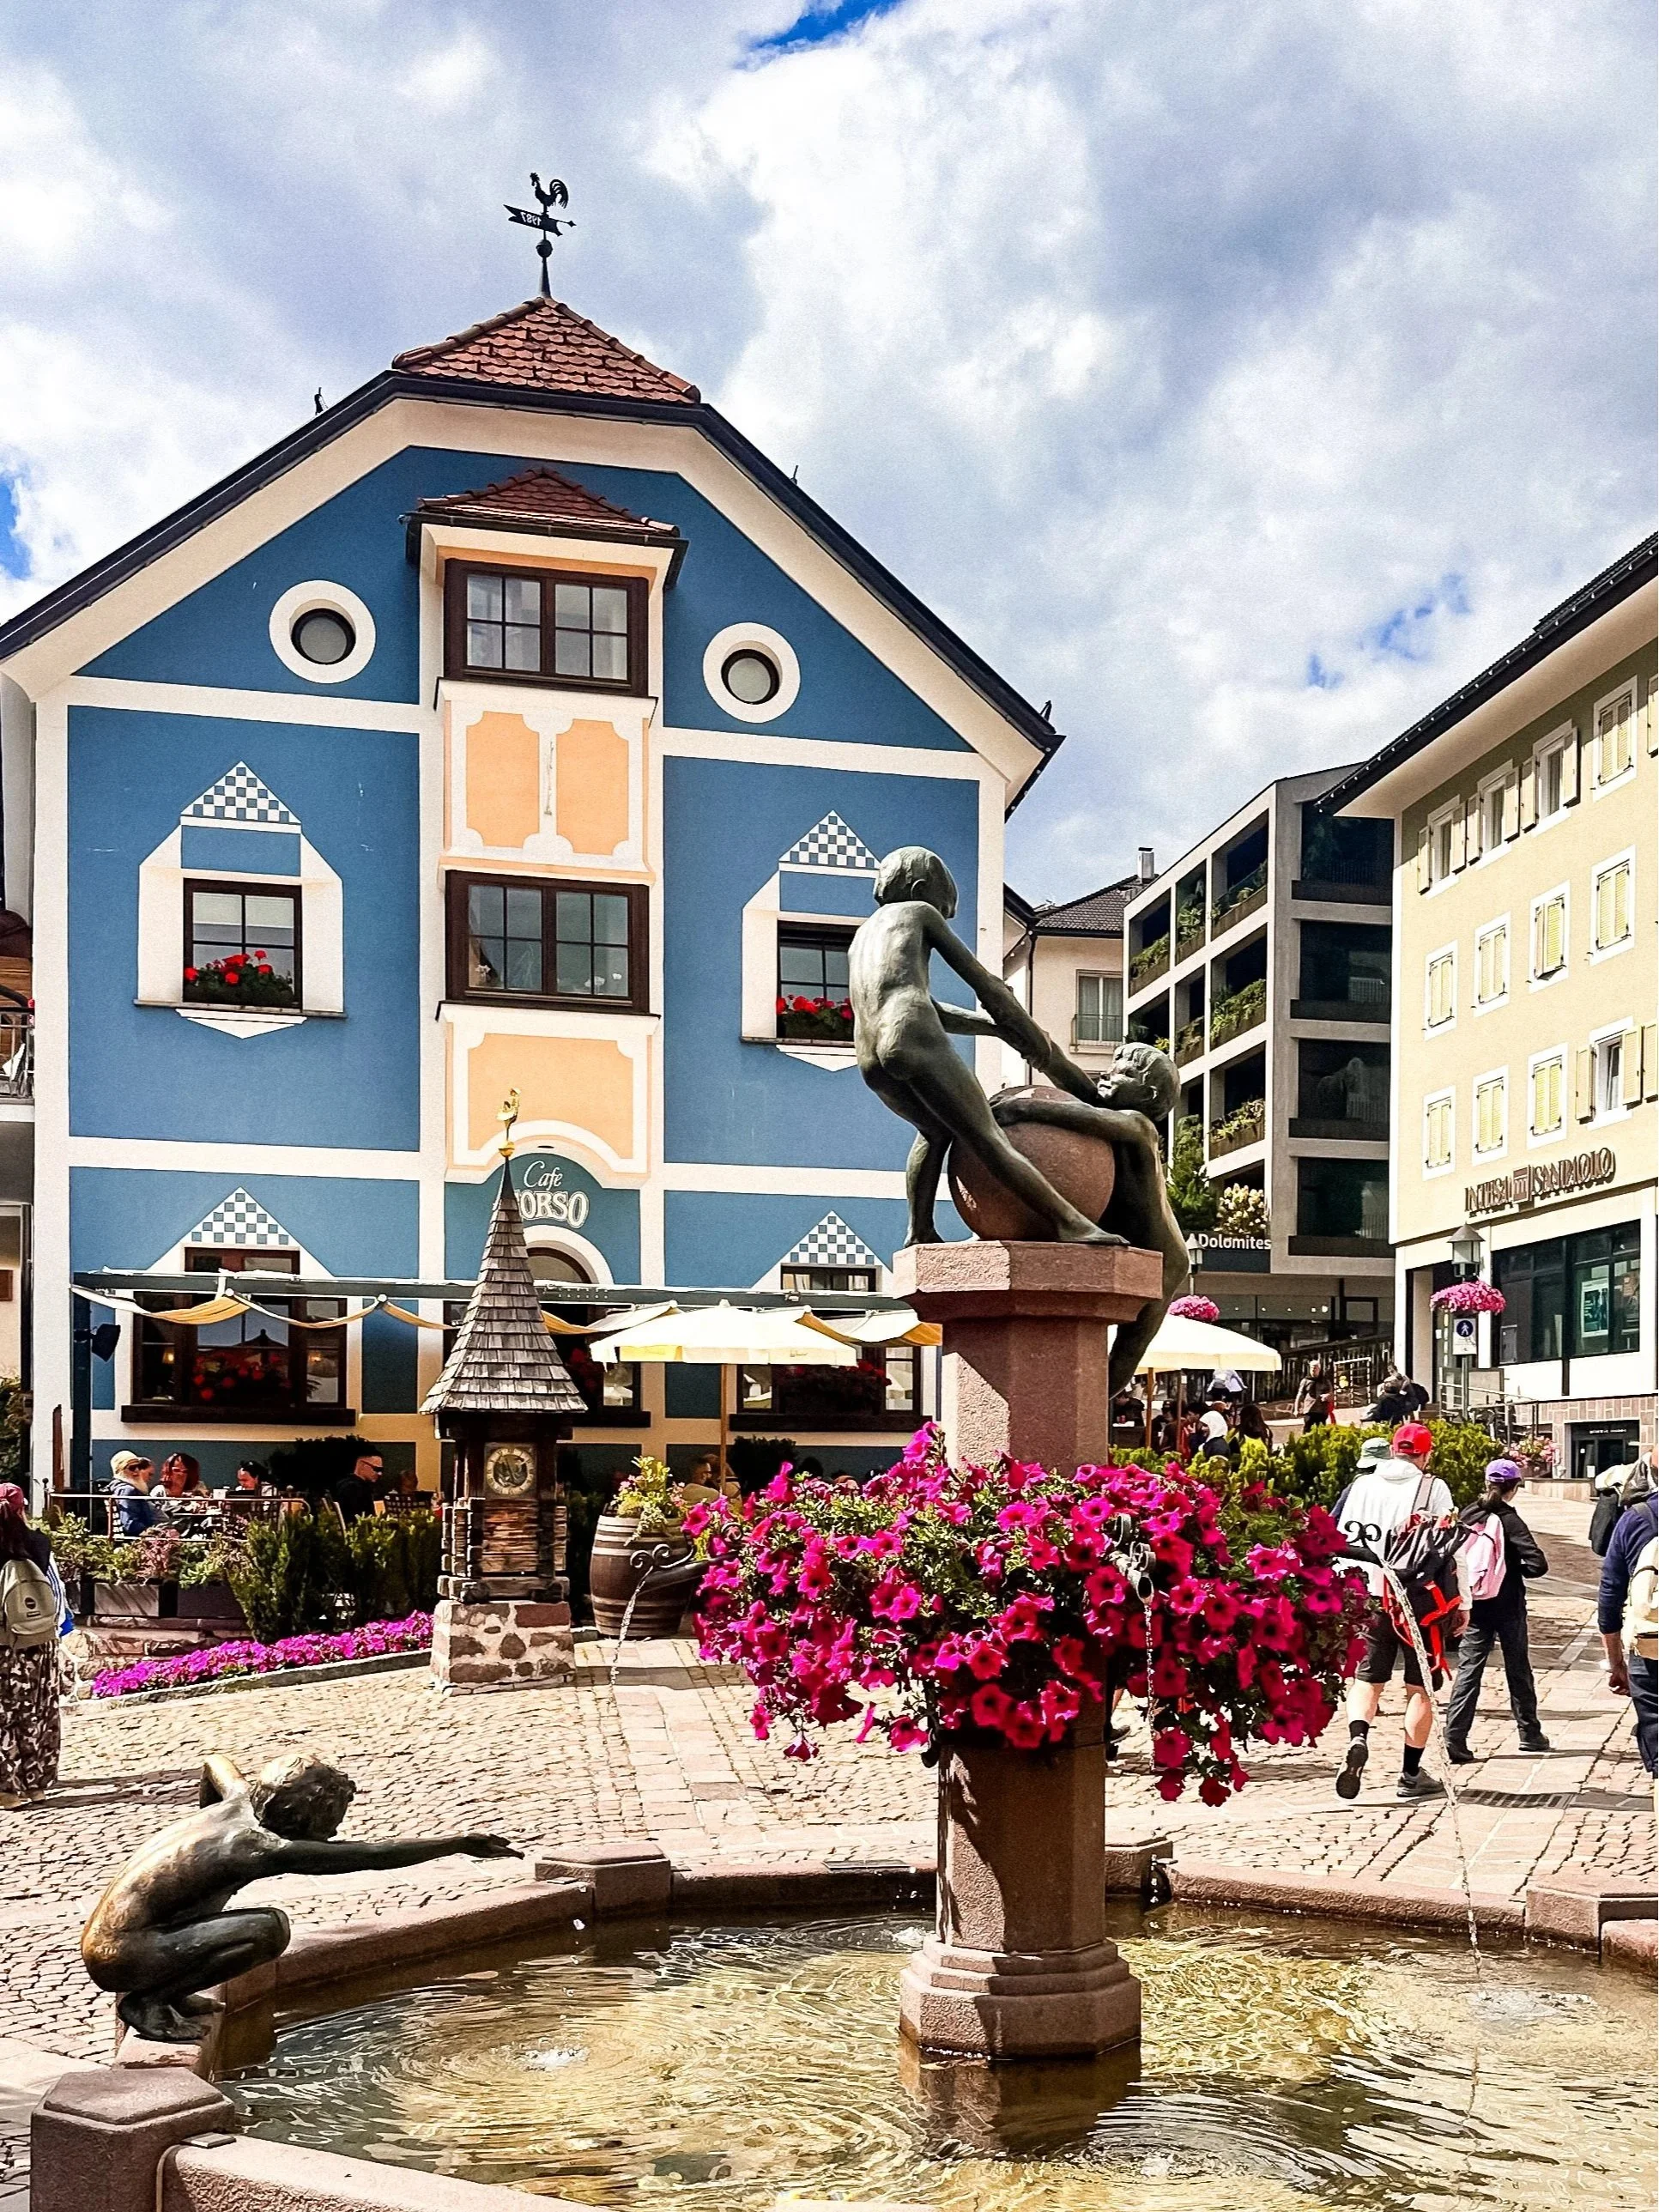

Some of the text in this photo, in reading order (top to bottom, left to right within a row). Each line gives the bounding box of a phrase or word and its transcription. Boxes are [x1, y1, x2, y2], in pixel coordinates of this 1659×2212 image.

[524, 1161, 563, 1191] Cafe
[1532, 1148, 1614, 1194] SANPAOLO
[1199, 1233, 1271, 1249] Dolomites
